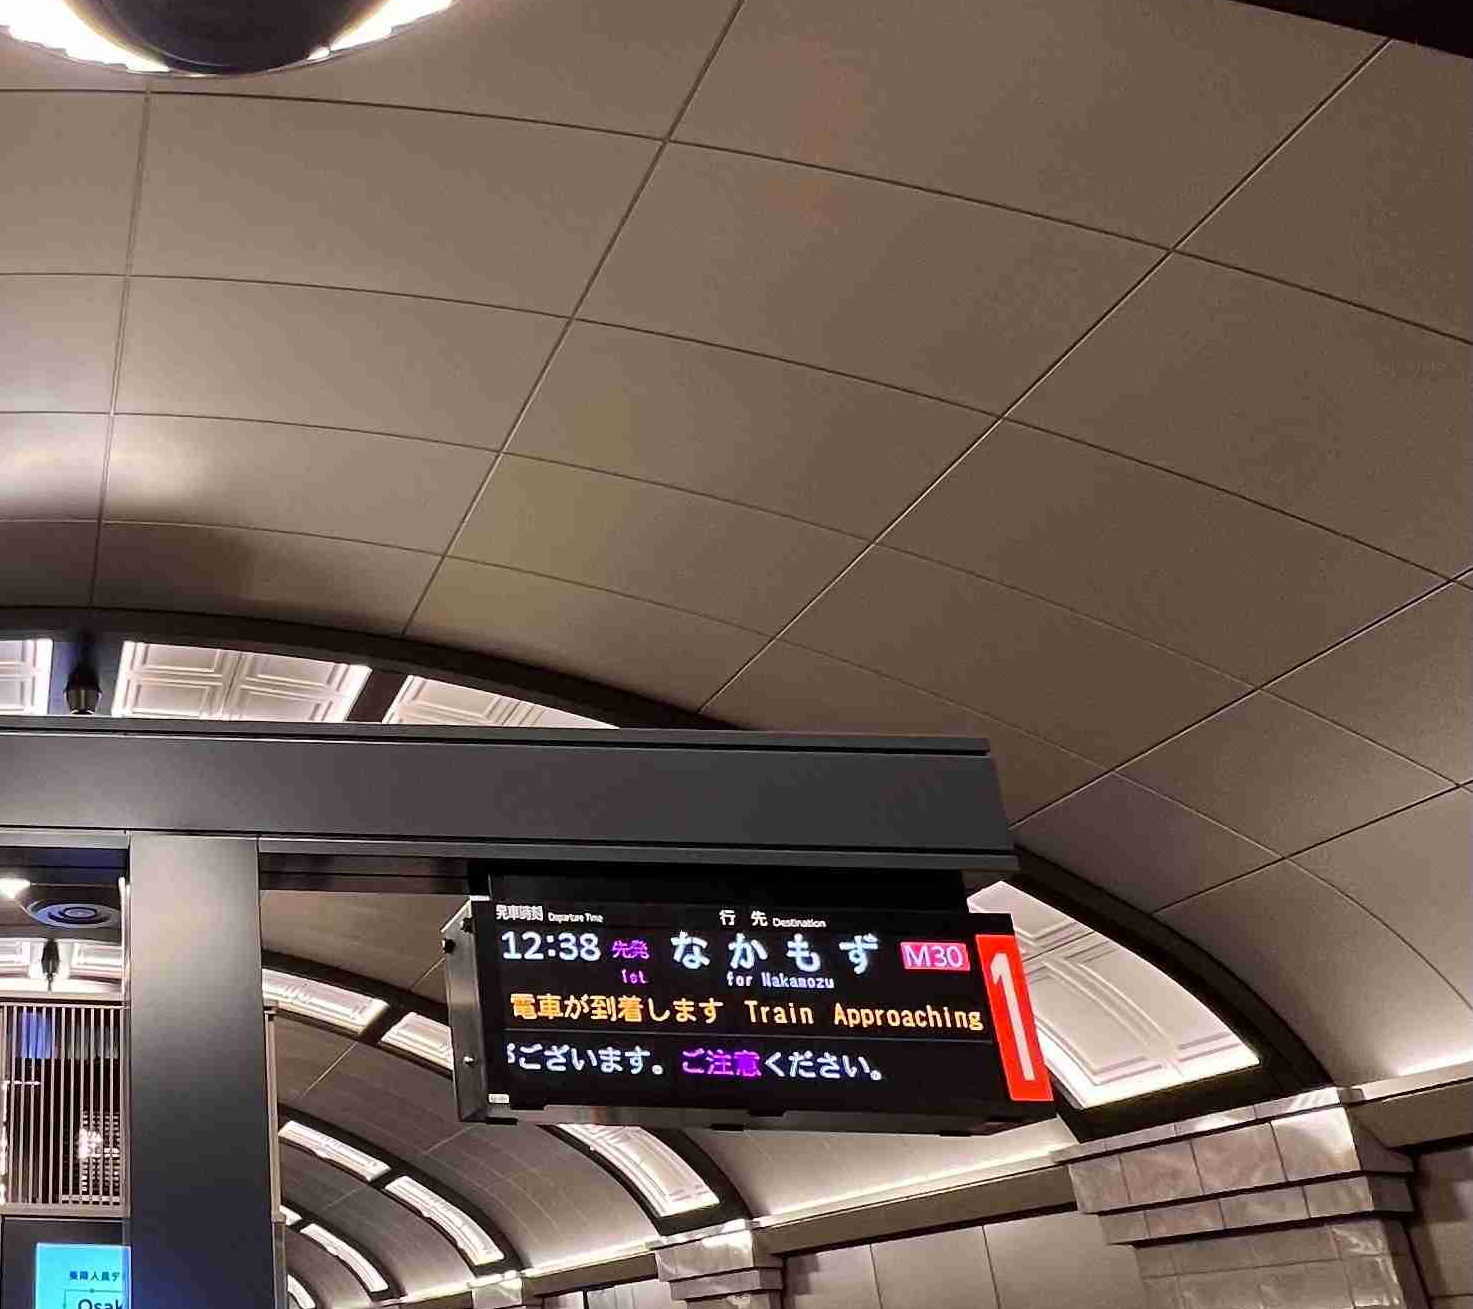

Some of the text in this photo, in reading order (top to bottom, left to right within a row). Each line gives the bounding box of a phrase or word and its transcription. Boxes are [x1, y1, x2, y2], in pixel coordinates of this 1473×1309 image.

[772, 917, 827, 929] Destination
[501, 930, 651, 962] 12:38 先発
[670, 931, 879, 975] なかもず
[904, 944, 963, 968] M30
[727, 971, 835, 990] for Nakamozu
[510, 992, 724, 1026] 電車が到着します
[744, 999, 985, 1032] Train Approaching
[990, 951, 1035, 1082] 1
